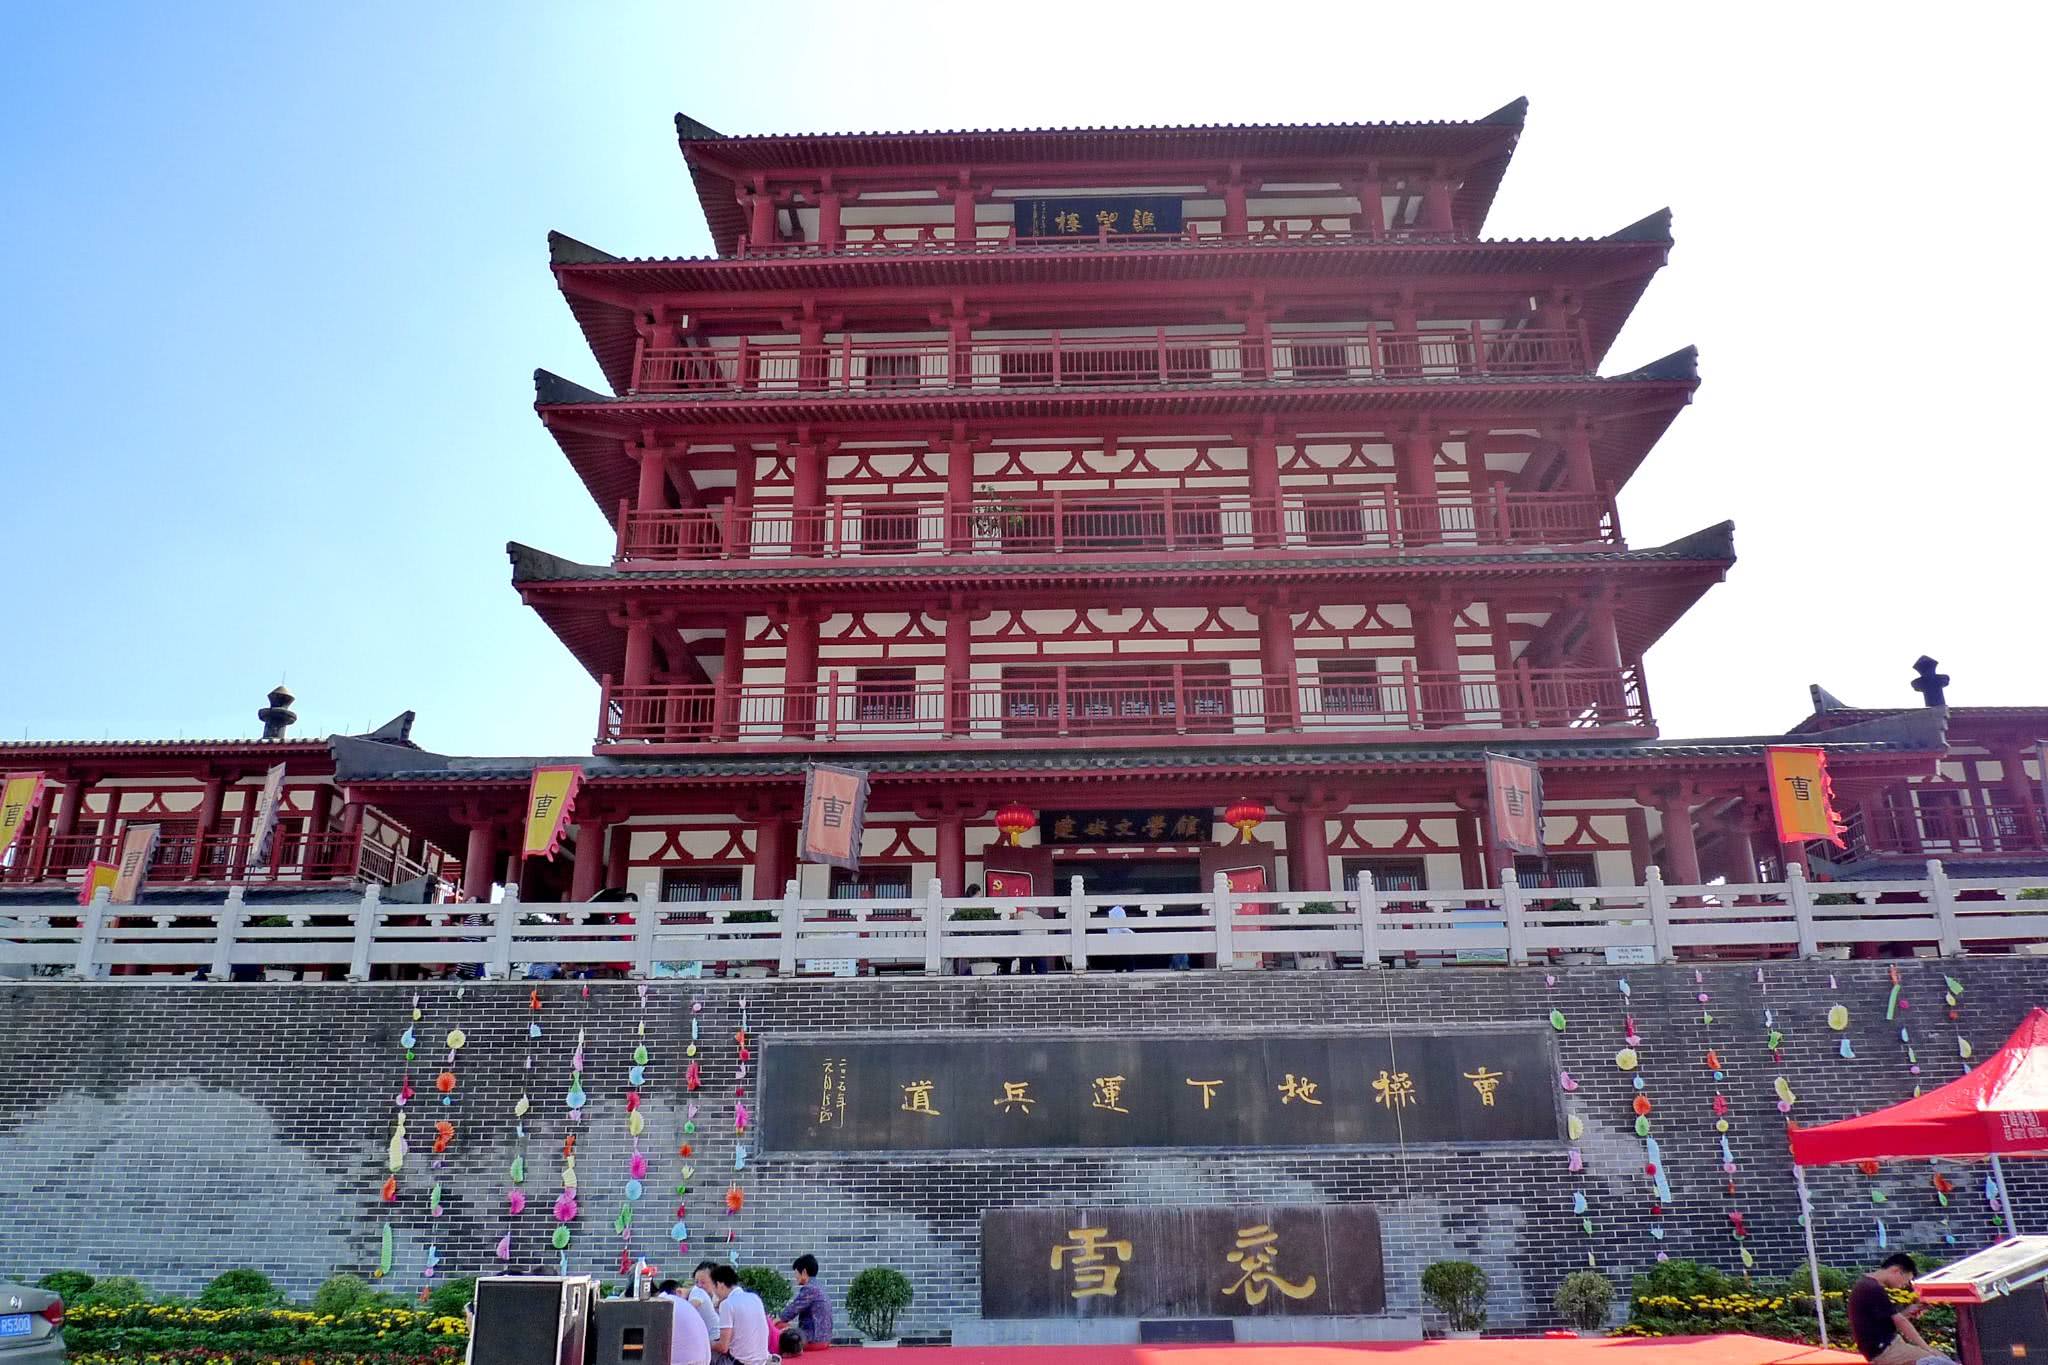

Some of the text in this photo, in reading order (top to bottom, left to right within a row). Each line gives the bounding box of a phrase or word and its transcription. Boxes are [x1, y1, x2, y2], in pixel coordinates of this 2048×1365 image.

[1783, 776, 1812, 800] 曹
[534, 794, 558, 818] 曹
[817, 795, 851, 828] 曹
[1499, 785, 1530, 817] 曹
[4, 802, 23, 827] 曹
